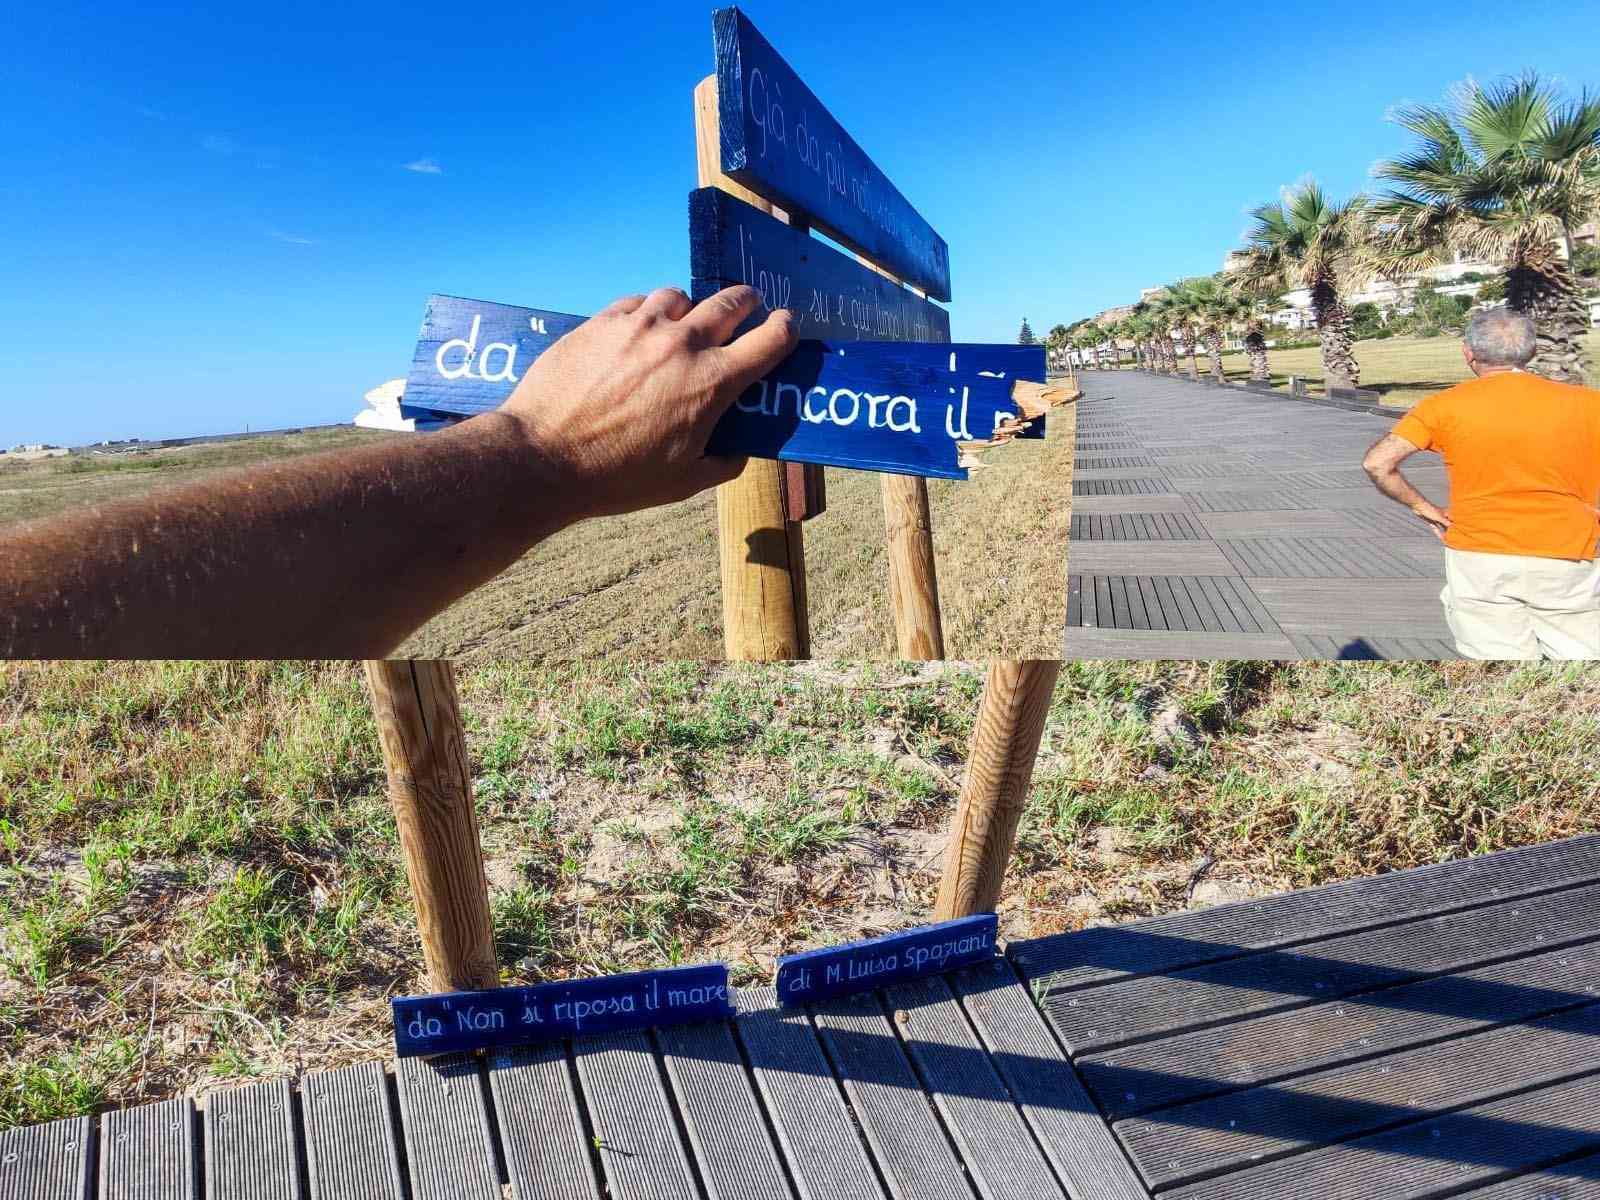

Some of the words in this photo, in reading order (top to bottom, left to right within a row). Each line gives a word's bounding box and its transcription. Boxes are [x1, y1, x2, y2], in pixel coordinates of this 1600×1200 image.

[736, 379, 921, 434] ancora
[945, 385, 974, 440] il
[826, 962, 845, 985] M.
[848, 953, 897, 979] Luisa
[554, 991, 635, 1030] riposa
[645, 978, 660, 1010] il
[667, 983, 728, 1007] mare
